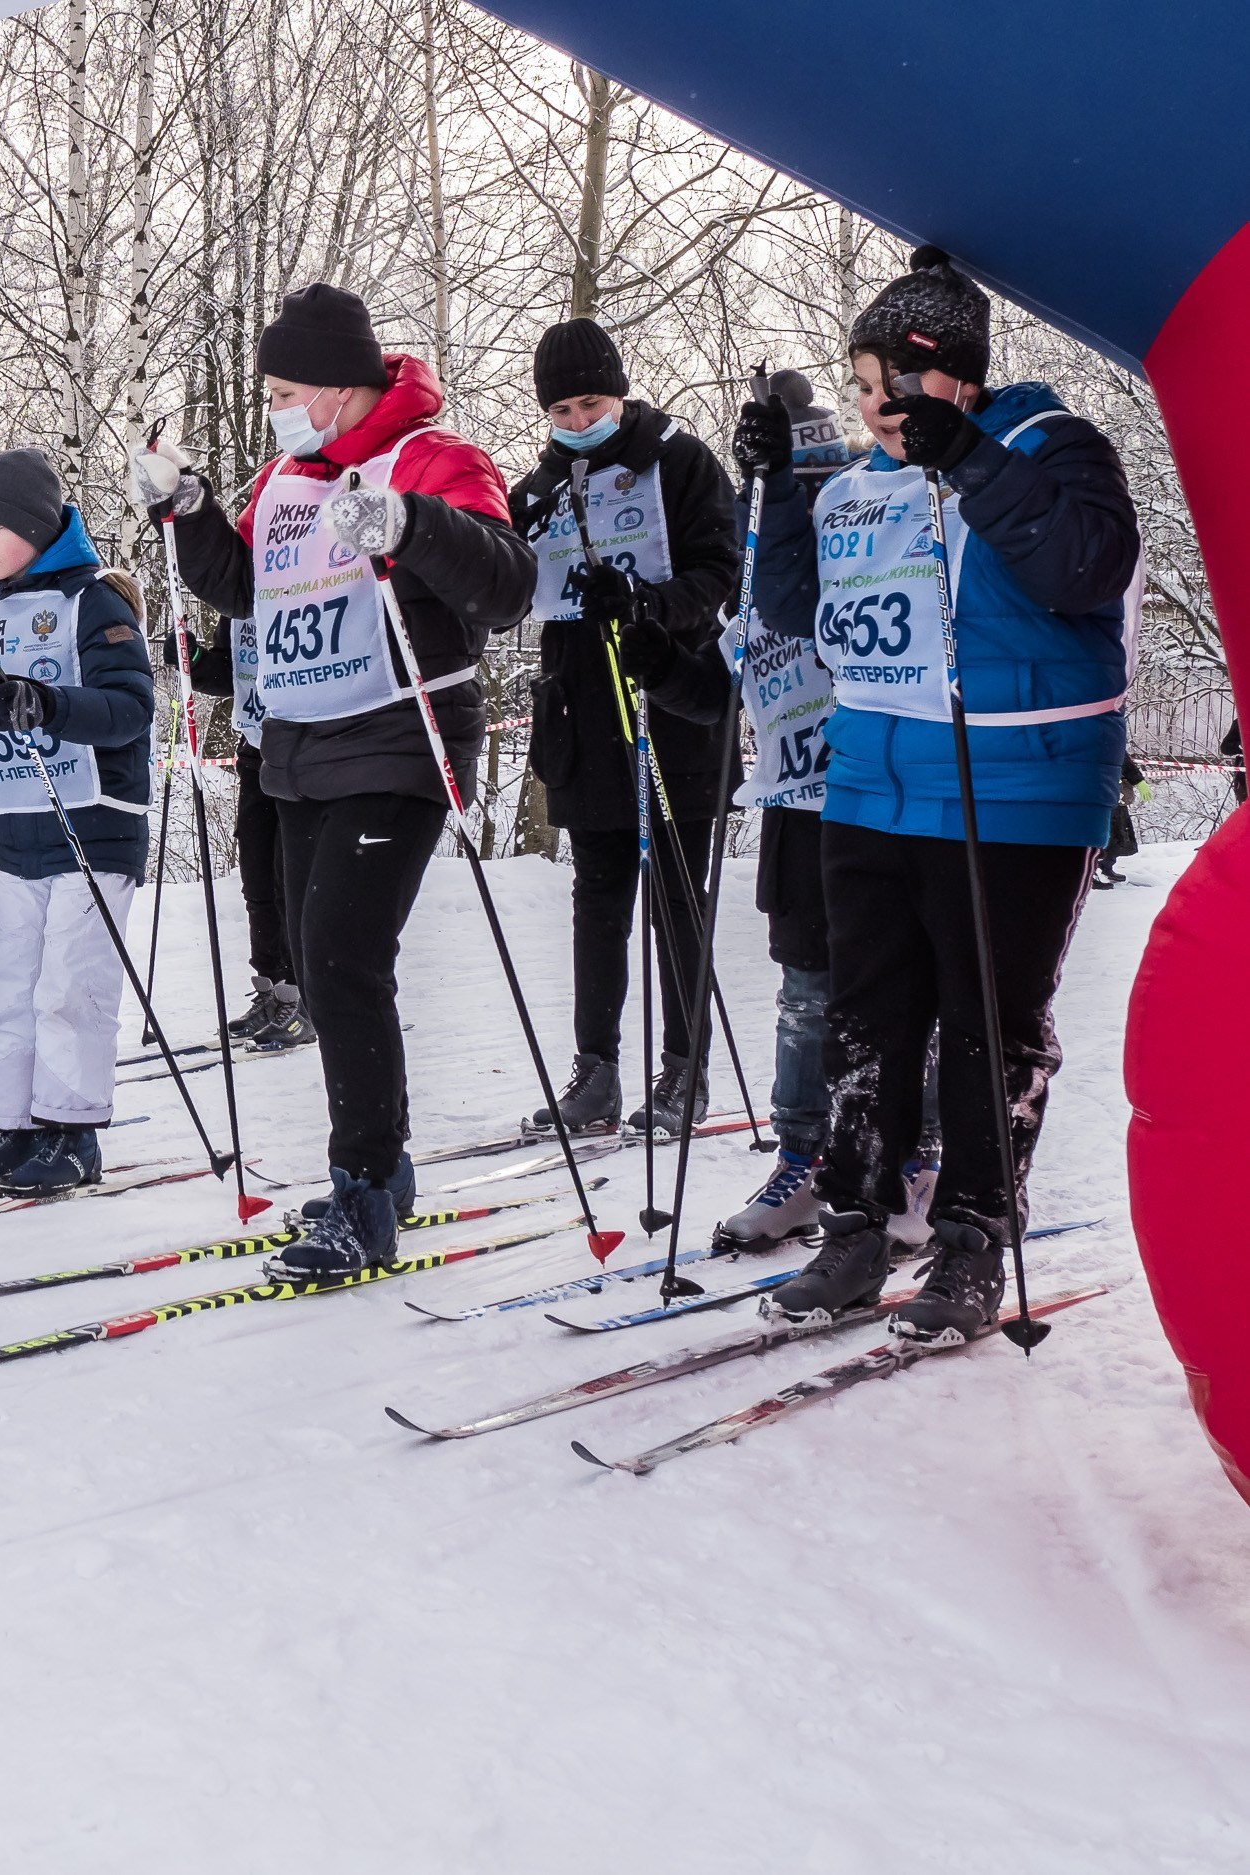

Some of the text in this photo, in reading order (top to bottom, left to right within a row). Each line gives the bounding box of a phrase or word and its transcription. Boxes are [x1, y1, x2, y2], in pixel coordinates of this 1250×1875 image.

[928, 491, 941, 541] STC
[609, 531, 648, 545] ЖИЗНИ
[821, 531, 875, 561] 2021
[290, 580, 319, 594] ОРМА
[320, 567, 364, 588] ЖИЗНИ
[735, 547, 755, 648] SPORTER
[265, 595, 349, 665] 4537
[935, 559, 955, 669] SPORTER
[263, 656, 372, 690] САНКТ-ПЕТЕРБУРГ
[752, 641, 802, 683] РОССИИ
[758, 665, 804, 709] 2021
